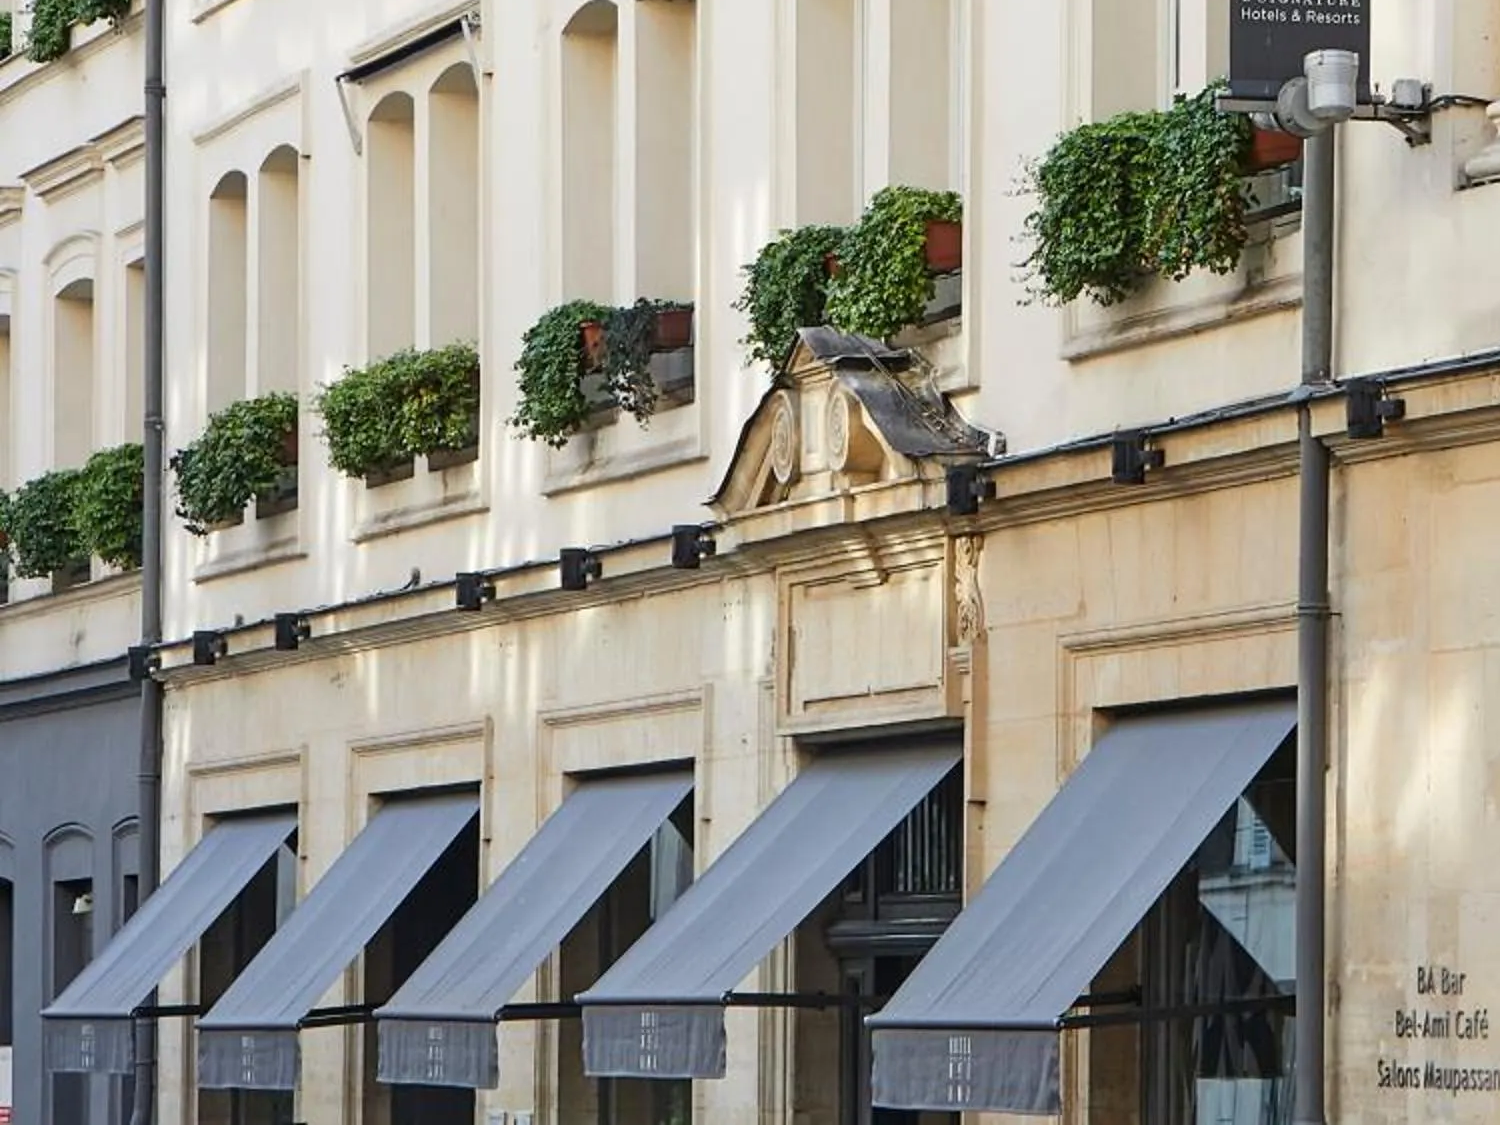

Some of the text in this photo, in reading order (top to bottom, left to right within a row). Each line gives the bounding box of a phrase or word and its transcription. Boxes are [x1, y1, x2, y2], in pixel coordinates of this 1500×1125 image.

[1241, 7, 1360, 24] Hotels & Resorts
[1417, 966, 1467, 996] BA Bar
[1455, 1008, 1489, 1040] Café
[1377, 1058, 1421, 1089] Salons
